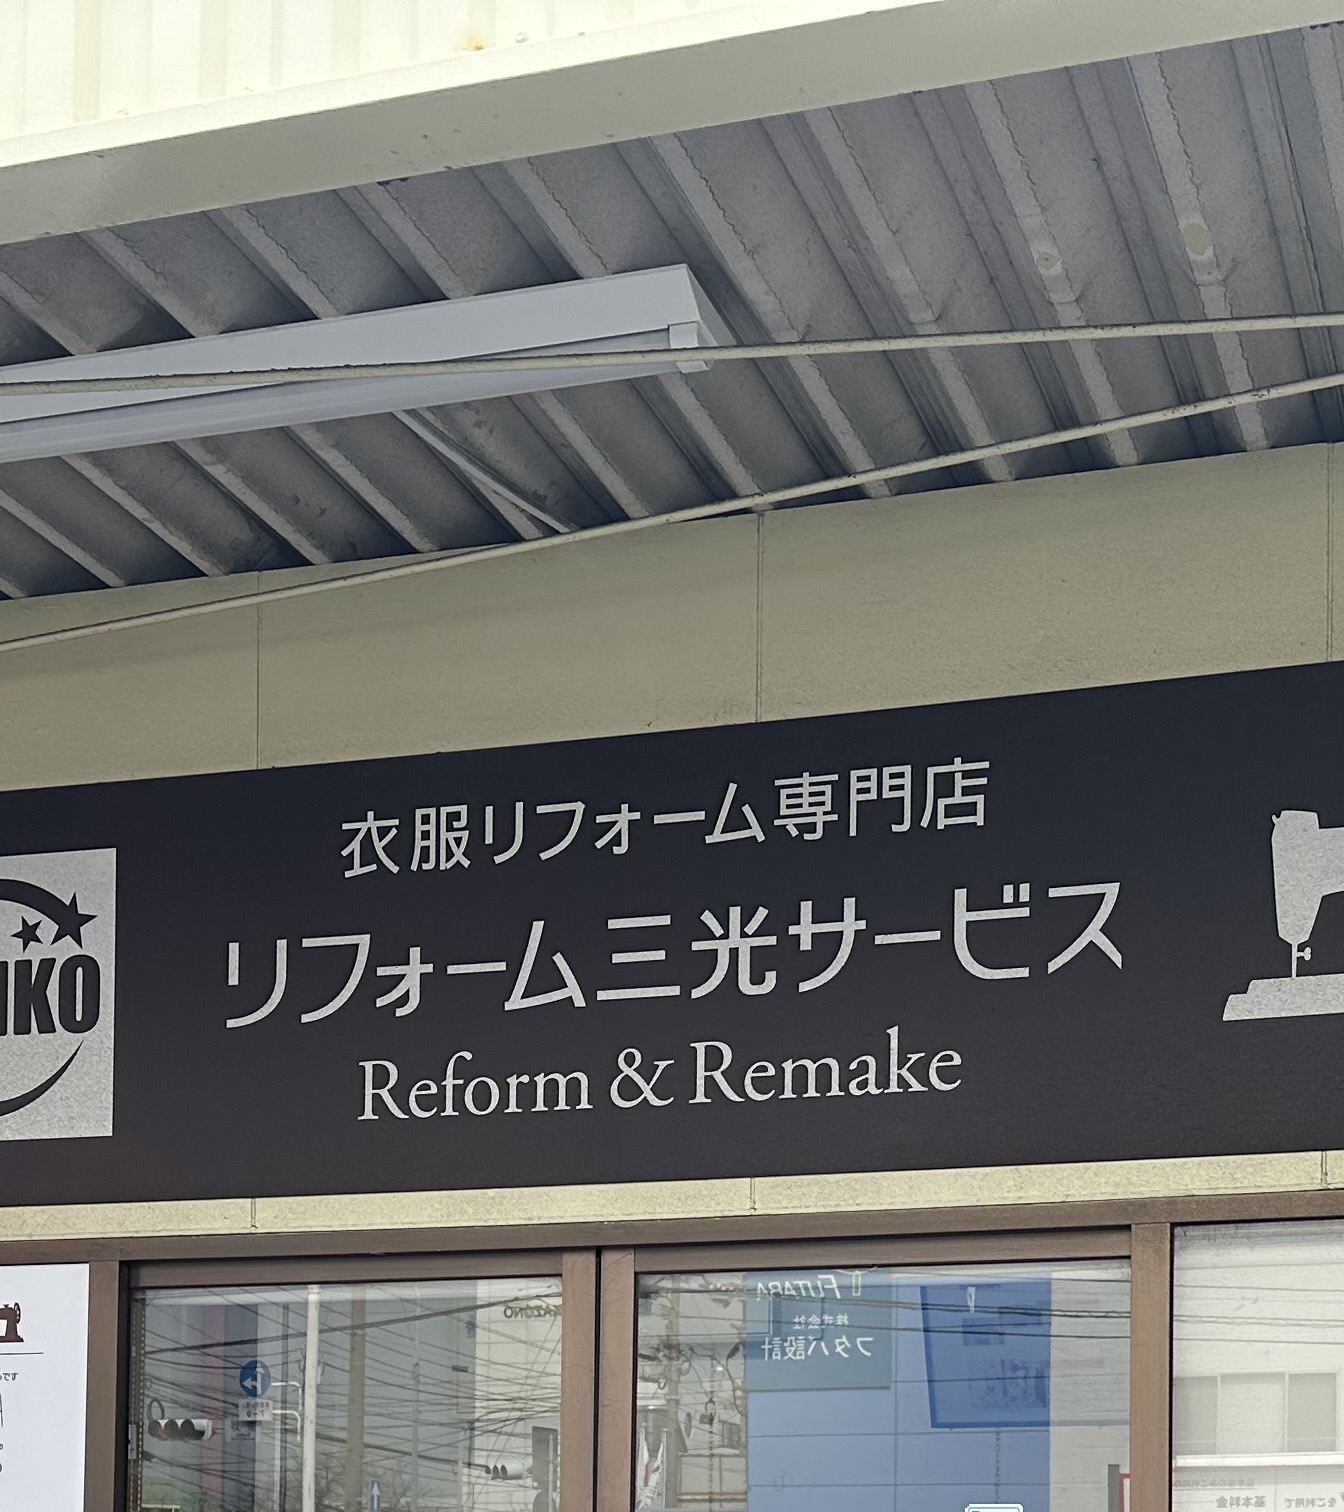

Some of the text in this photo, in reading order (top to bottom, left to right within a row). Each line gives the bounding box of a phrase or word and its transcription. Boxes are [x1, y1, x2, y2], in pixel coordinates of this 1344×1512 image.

[340, 757, 990, 878] 衣服リフォーム専門店
[226, 881, 1123, 1028] リフォーム三光サービス
[358, 1026, 963, 1121] Reform & Remake
